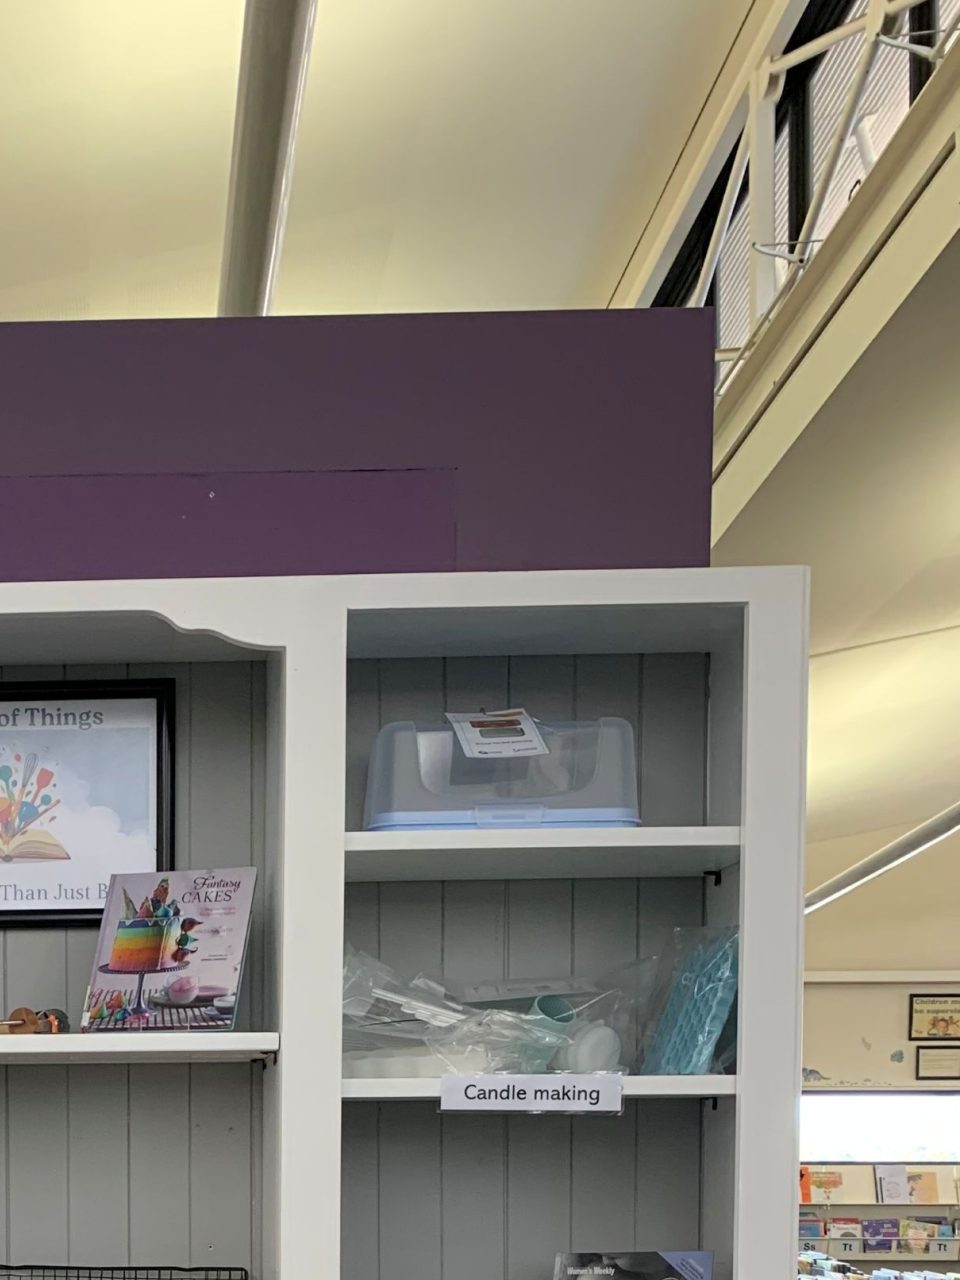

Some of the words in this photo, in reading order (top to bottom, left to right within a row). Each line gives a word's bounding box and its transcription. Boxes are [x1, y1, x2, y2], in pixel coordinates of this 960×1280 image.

[25, 707, 104, 730] Things
[53, 883, 91, 900] Just
[193, 875, 241, 893] Fantasy
[181, 889, 233, 904] CAKES
[464, 1084, 527, 1101] Candle
[534, 1085, 600, 1106] making
[803, 1242, 816, 1251] Ss
[842, 1243, 853, 1251] Tt
[937, 1243, 947, 1251] Tt
